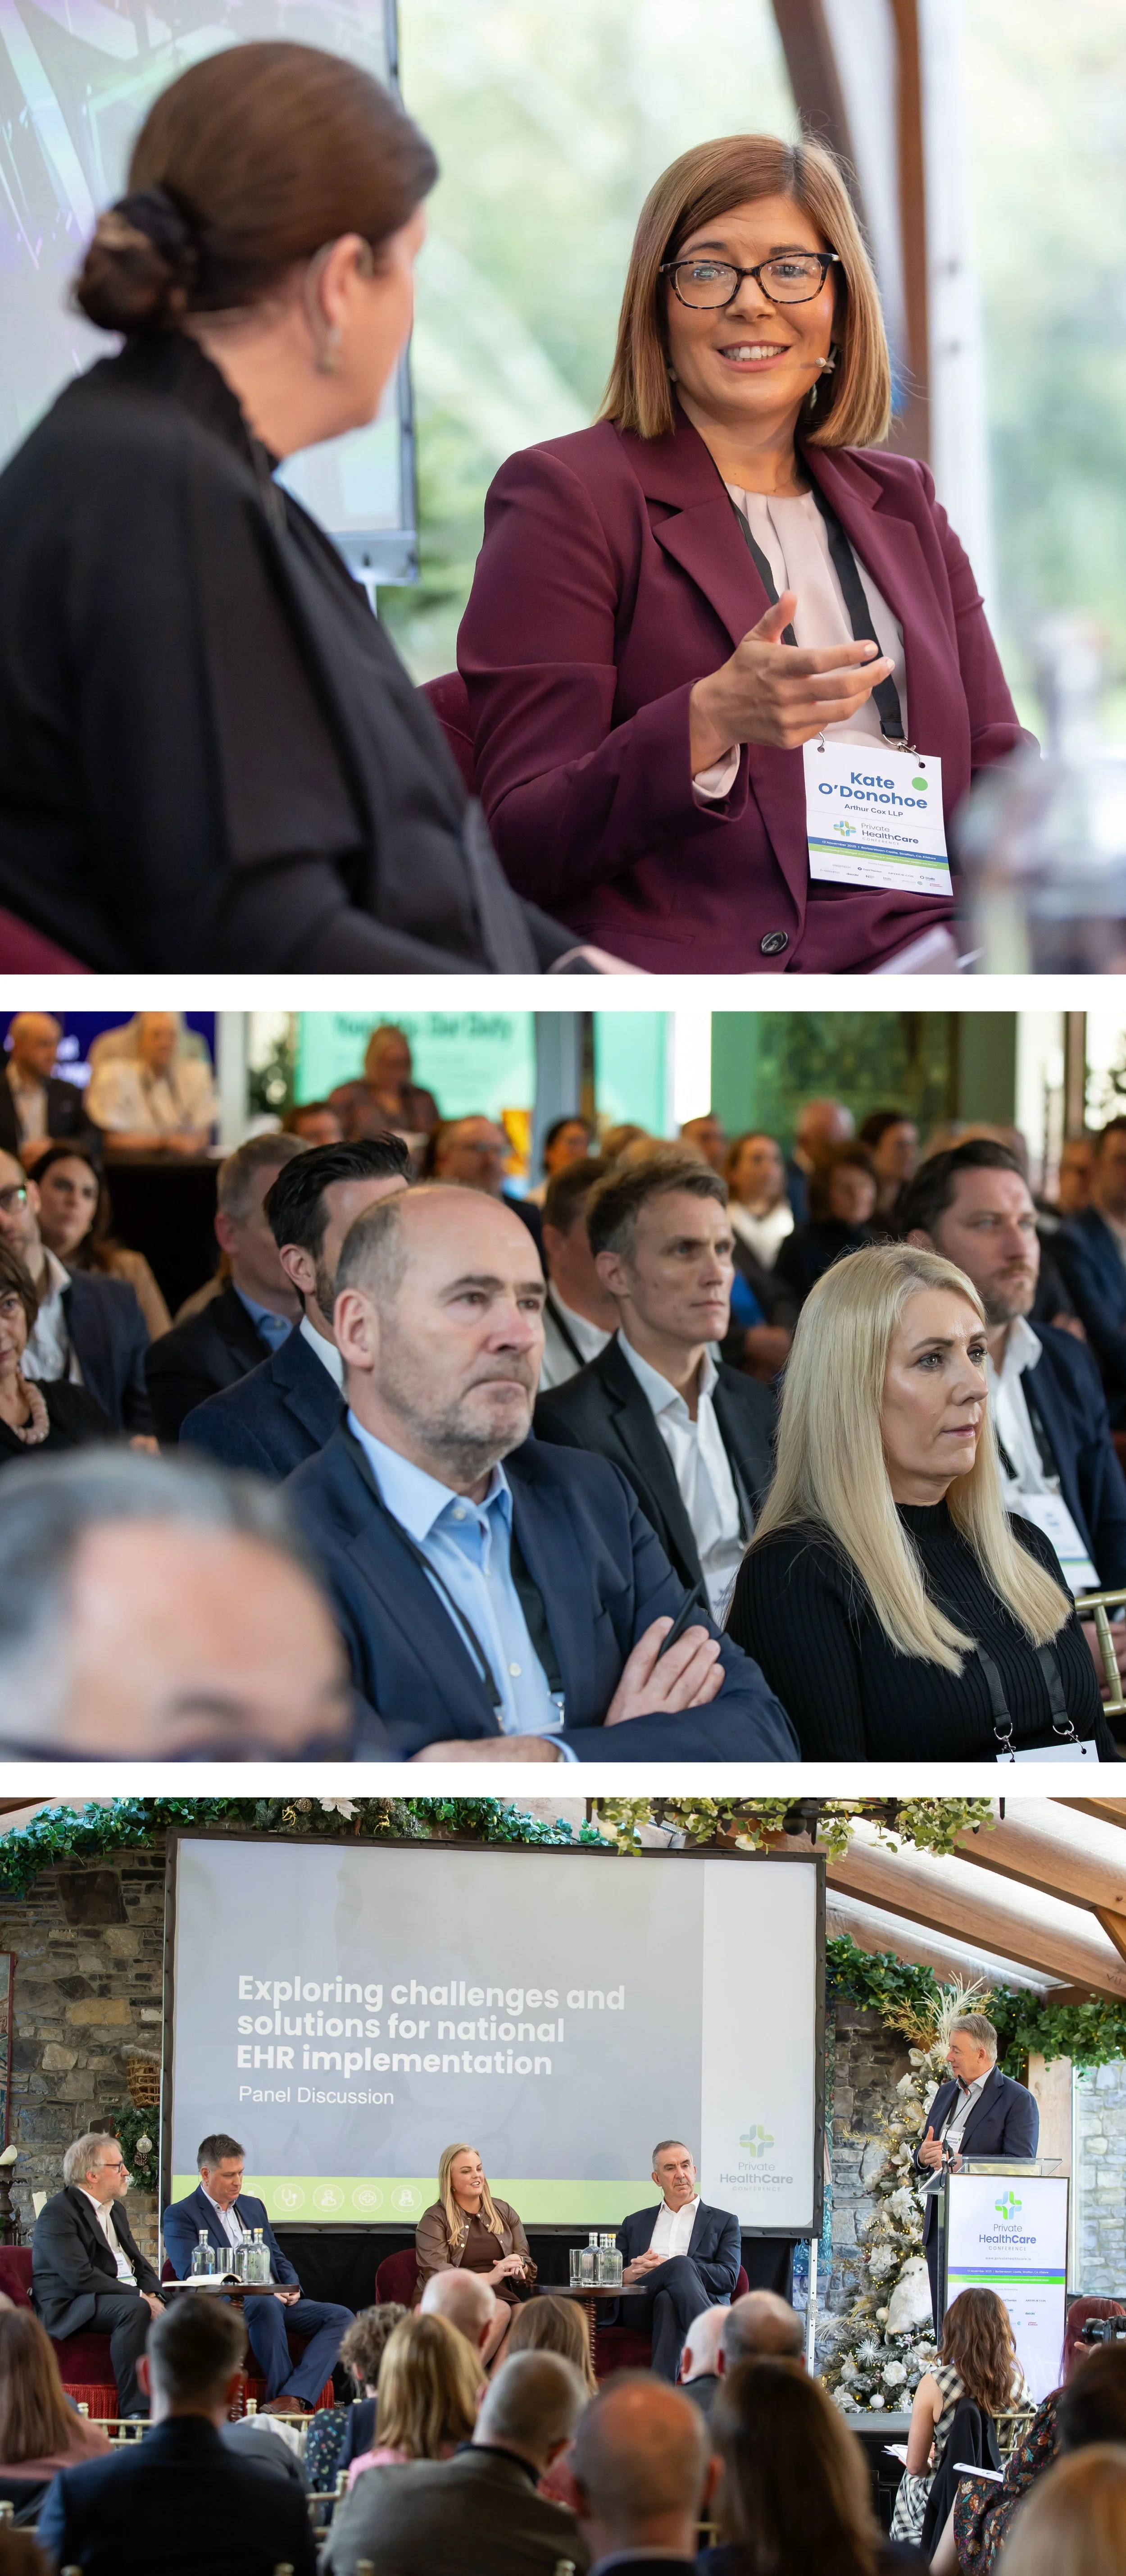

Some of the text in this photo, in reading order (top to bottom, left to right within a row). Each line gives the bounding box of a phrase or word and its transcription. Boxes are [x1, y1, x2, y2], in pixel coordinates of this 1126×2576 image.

[851, 772, 894, 789] Kate
[818, 783, 927, 808] O’Donohoe
[844, 804, 869, 812] Arthur
[861, 823, 890, 832] Private
[862, 830, 919, 843] HealthCare
[863, 837, 899, 845] CONFERENCE
[239, 1975, 625, 2016] Exploring challenges and
[237, 2010, 564, 2042] solutions for national
[237, 2043, 552, 2079] EHR implementation
[239, 2086, 394, 2105] Panel Discussion
[739, 2162, 775, 2171] Private
[720, 2174, 793, 2184] HealthCare
[994, 2224, 1022, 2232] Private
[979, 2234, 1036, 2243] HealthCare
